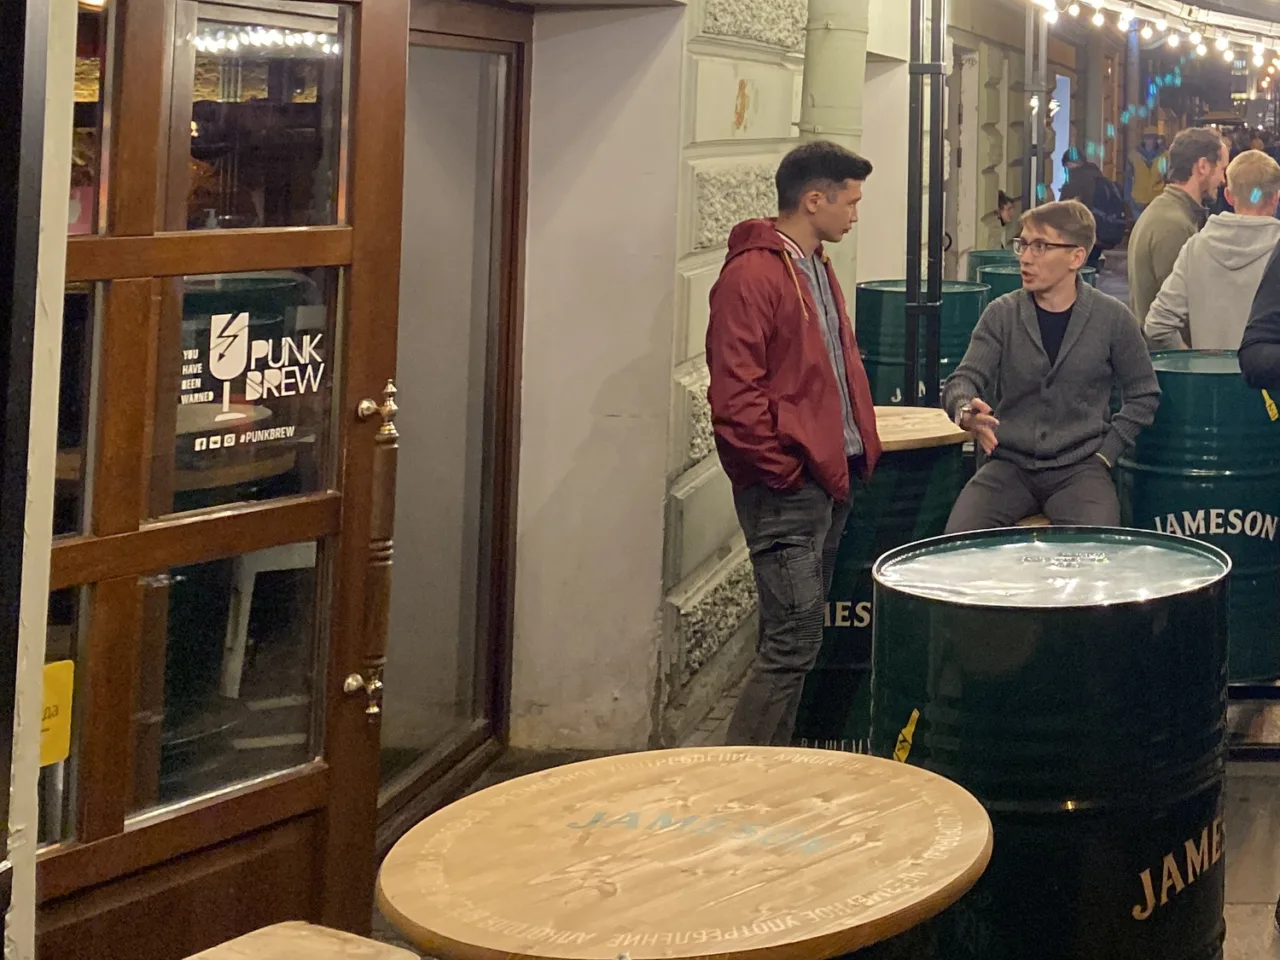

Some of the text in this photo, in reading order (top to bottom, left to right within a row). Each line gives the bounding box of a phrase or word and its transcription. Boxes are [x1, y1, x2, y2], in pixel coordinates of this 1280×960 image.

[183, 348, 199, 360] YOU
[250, 333, 323, 370] PUNK
[182, 362, 203, 375] HAVE
[181, 378, 202, 390] BEEN
[245, 363, 325, 401] BREW
[180, 391, 215, 404] WARNED
[239, 425, 295, 443] #PUNKBREW
